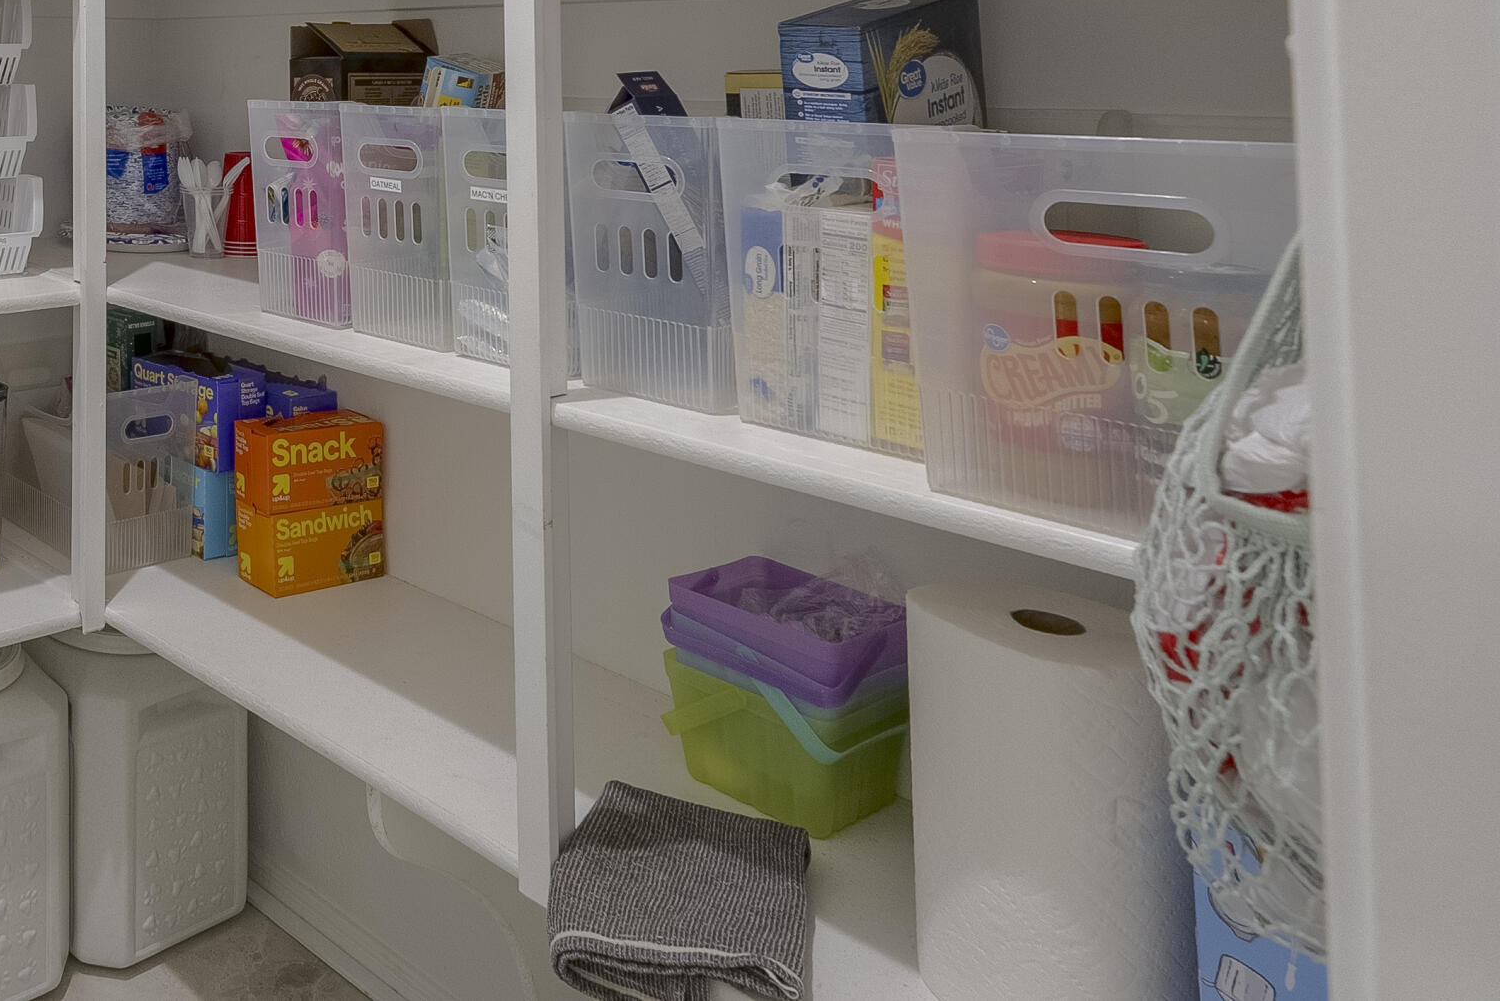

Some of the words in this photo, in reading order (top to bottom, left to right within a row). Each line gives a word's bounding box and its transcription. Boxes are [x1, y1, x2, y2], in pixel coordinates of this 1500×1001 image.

[814, 65, 841, 73] Instant
[901, 68, 922, 84] Great
[905, 79, 922, 91] Value
[927, 86, 965, 118] Instant
[371, 180, 401, 191] OATMEAL
[133, 363, 165, 387] Quart
[272, 431, 357, 468] Snack
[276, 505, 372, 540] Sandwich
